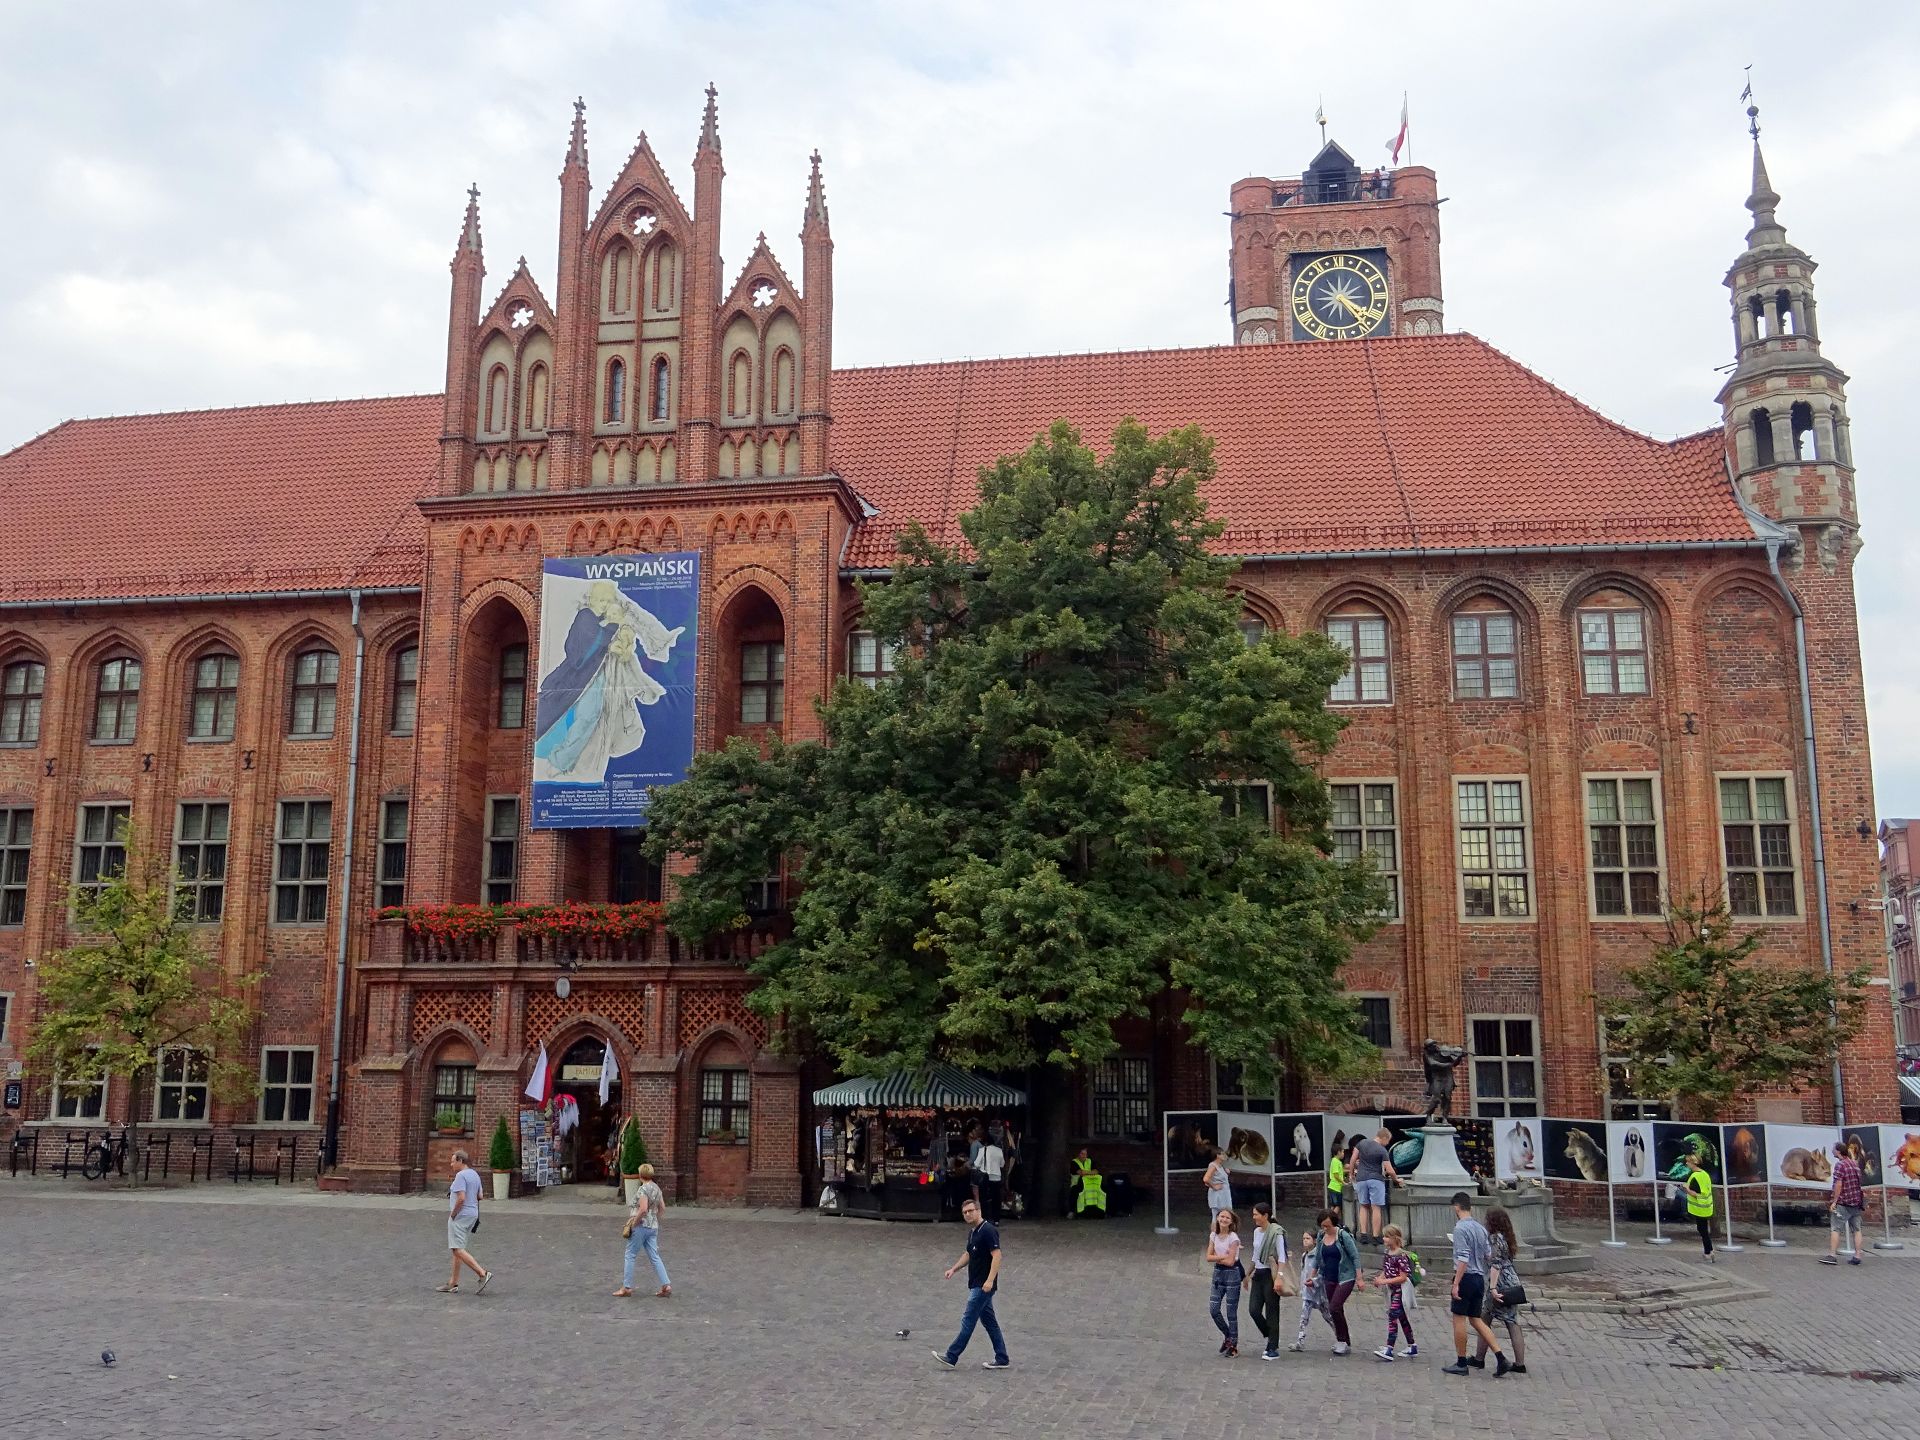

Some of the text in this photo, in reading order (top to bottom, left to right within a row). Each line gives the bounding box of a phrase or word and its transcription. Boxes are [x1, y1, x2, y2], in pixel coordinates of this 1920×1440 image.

[1333, 256, 1344, 267] XII
[1312, 262, 1324, 274] XI
[1368, 274, 1380, 282] II
[585, 557, 693, 579] WYSPIAŃSKI
